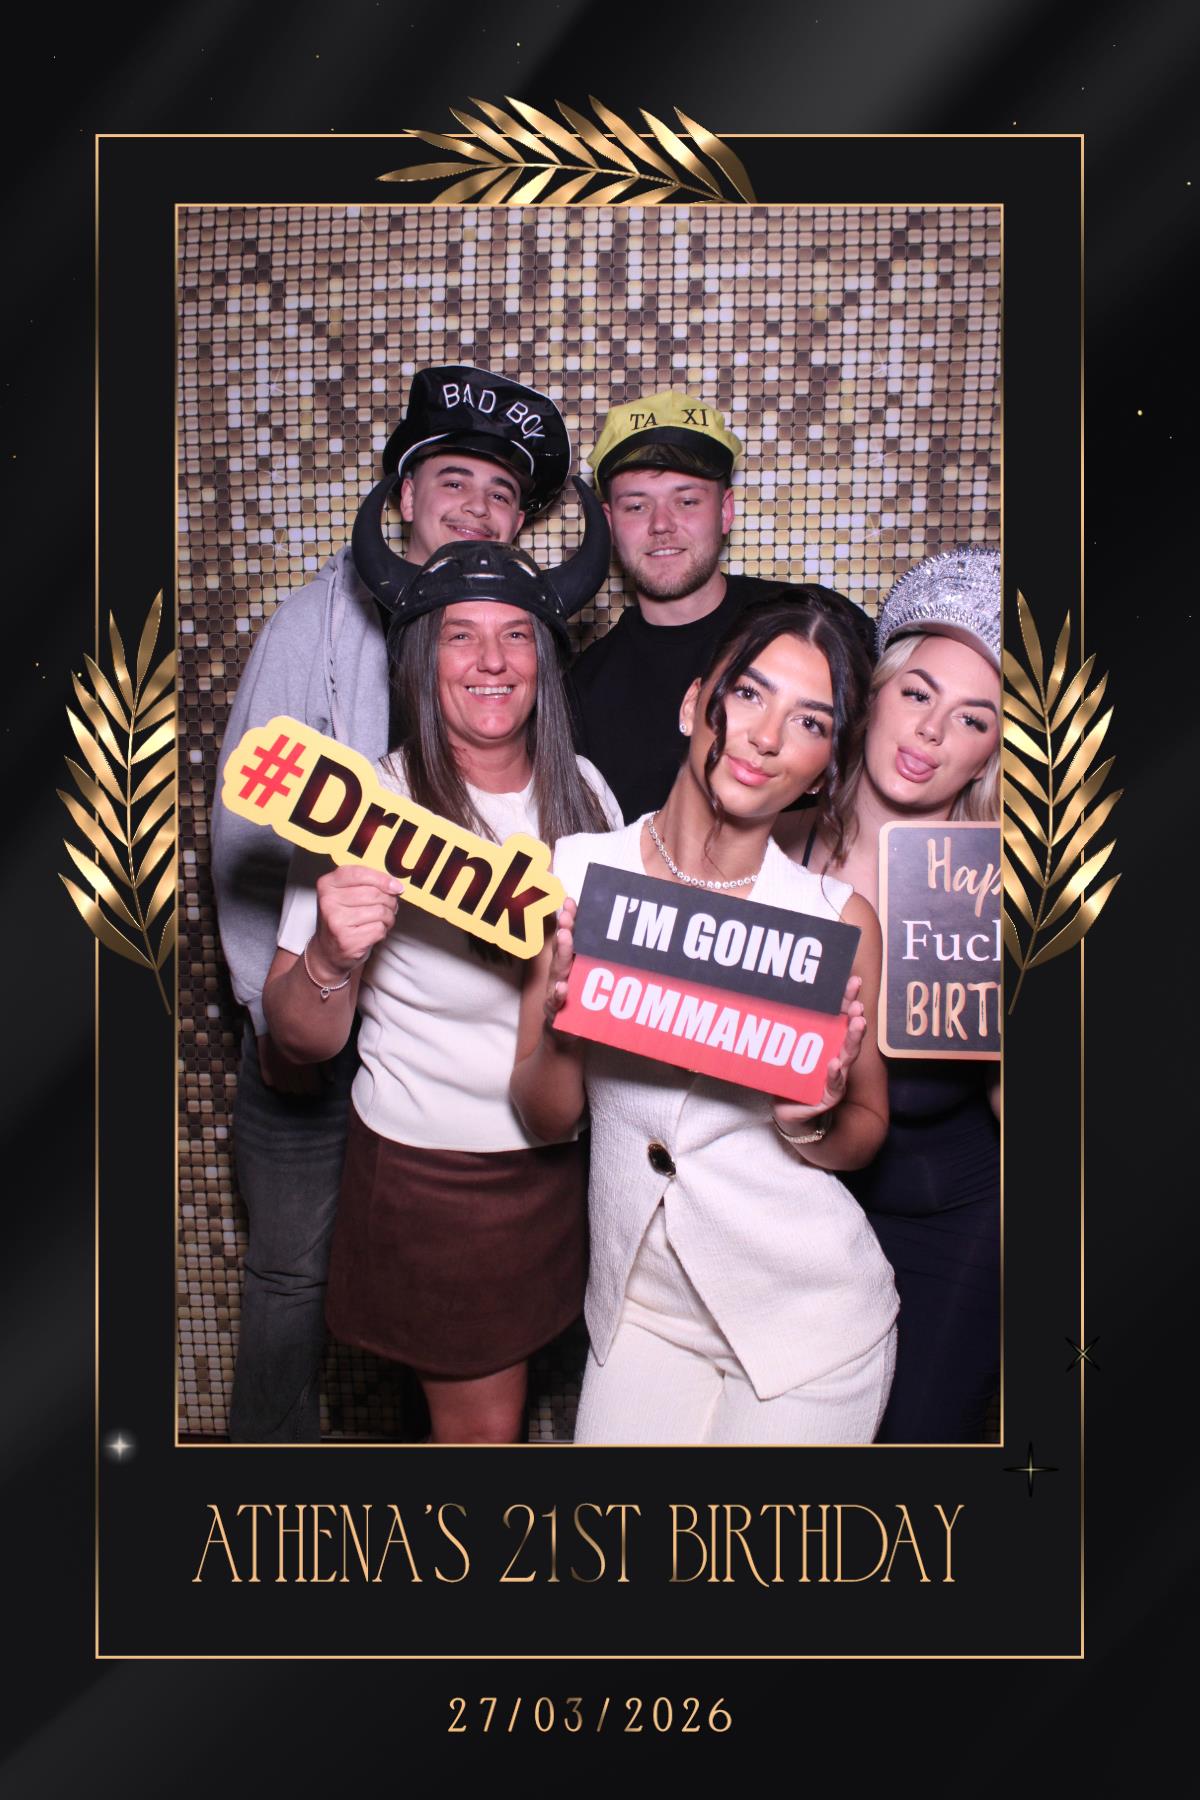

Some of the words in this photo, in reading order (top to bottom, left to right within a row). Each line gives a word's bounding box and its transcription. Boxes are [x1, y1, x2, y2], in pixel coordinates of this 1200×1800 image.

[442, 383, 497, 414] BAD
[506, 401, 546, 440] BOY
[238, 734, 550, 943] #Drunk
[606, 894, 679, 953] I'M
[682, 912, 824, 985] GOING
[580, 967, 825, 1075] COMMANDO
[906, 981, 1001, 1041] BIRT
